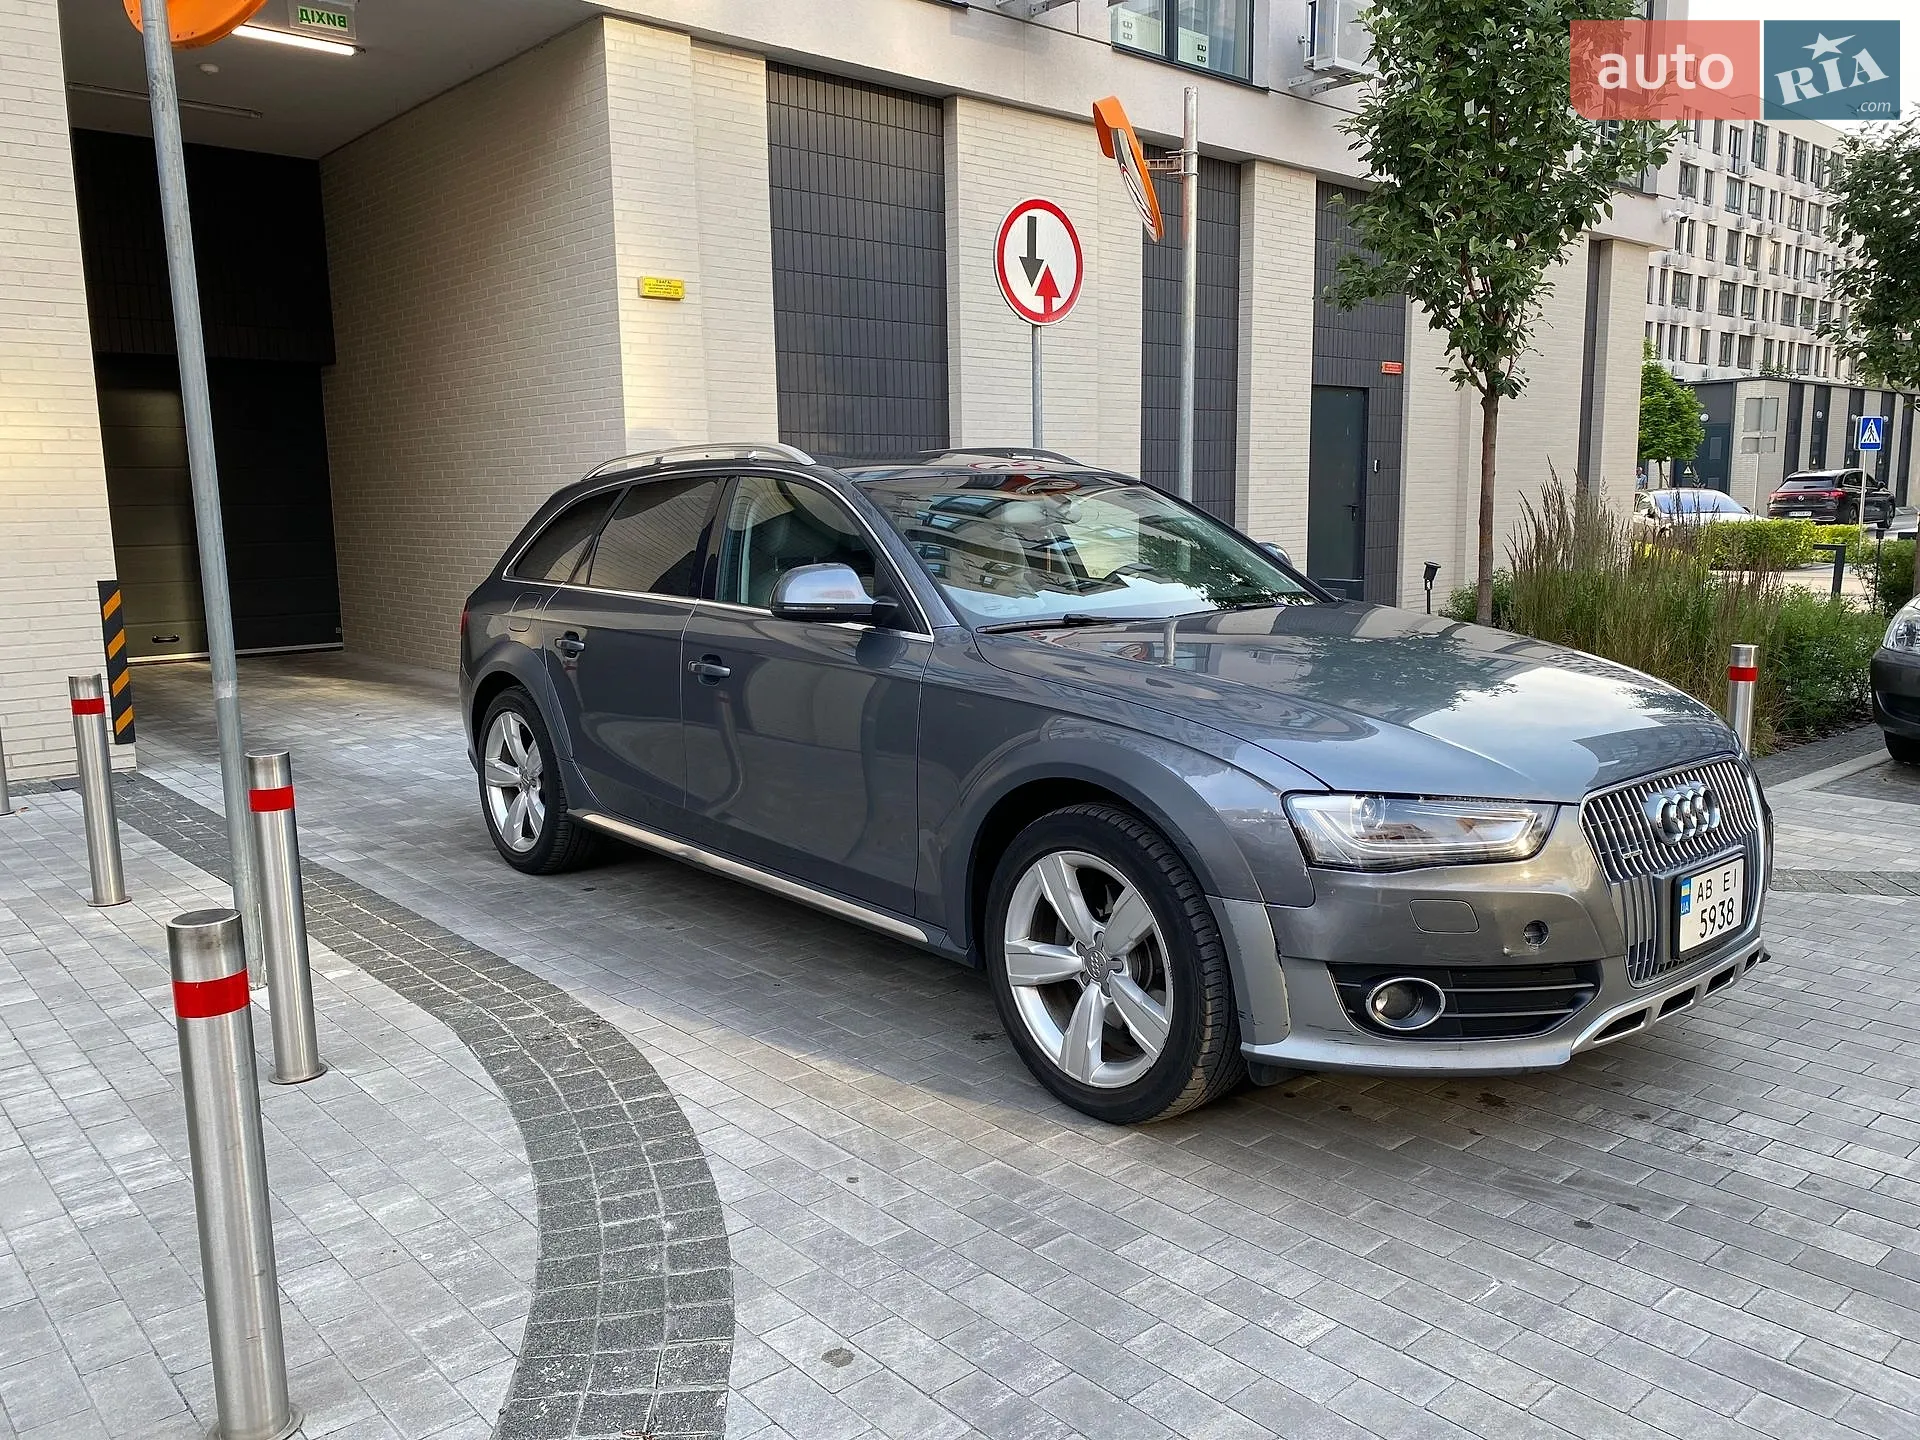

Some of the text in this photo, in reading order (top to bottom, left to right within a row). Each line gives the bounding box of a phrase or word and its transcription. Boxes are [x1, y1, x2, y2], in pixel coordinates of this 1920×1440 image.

[1696, 878, 1713, 903] AB
[1680, 901, 1690, 913] UA
[1699, 897, 1734, 938] 5938
